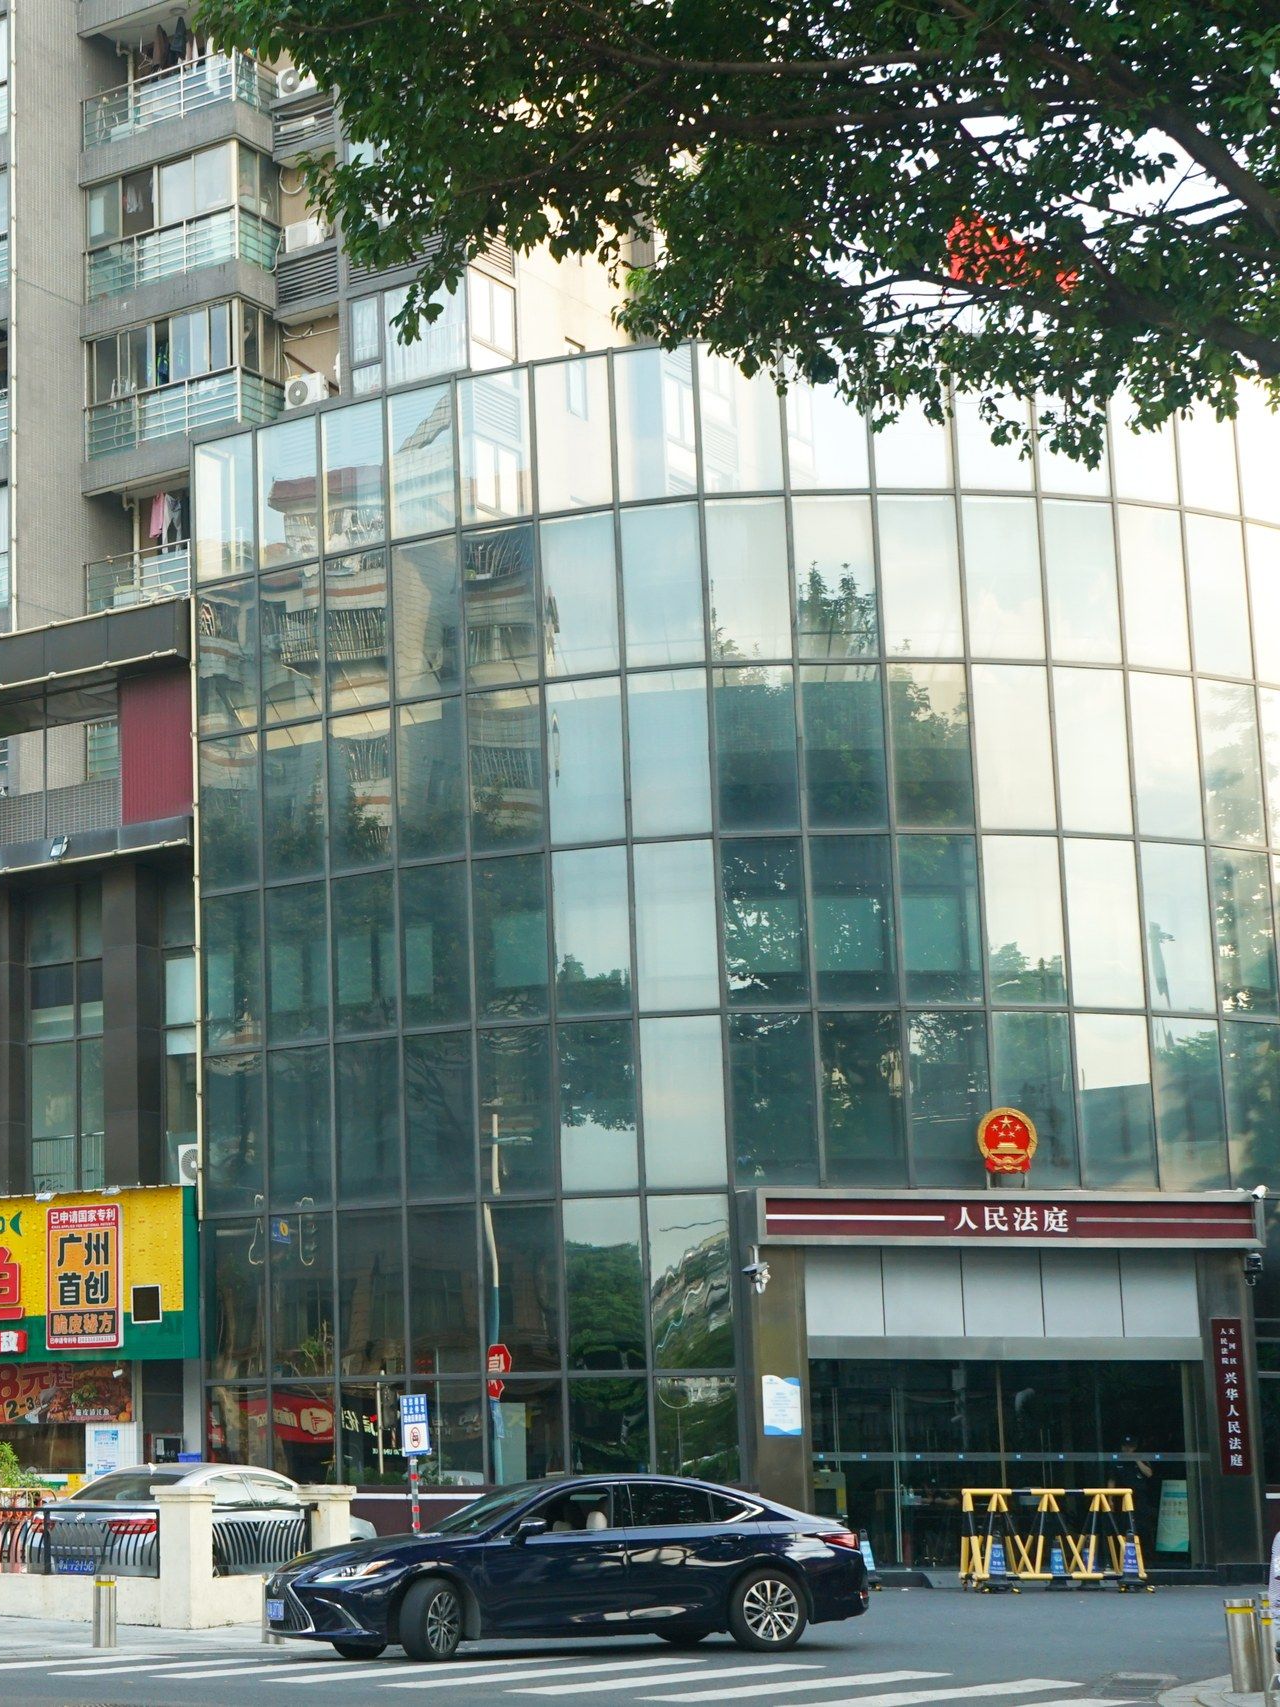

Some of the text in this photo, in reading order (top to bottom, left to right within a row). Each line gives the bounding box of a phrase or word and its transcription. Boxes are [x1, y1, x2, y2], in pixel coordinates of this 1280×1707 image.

[50, 1208, 116, 1224] 已申请国家专利
[953, 1206, 1070, 1233] 人民法庭
[57, 1231, 110, 1267] 广州
[57, 1270, 110, 1306] 首创
[52, 1311, 114, 1335] 脆皮秘方
[1220, 1327, 1230, 1365] 人民法院
[1227, 1327, 1238, 1365] 天河区
[1224, 1371, 1244, 1467] 兴华人民法庭
